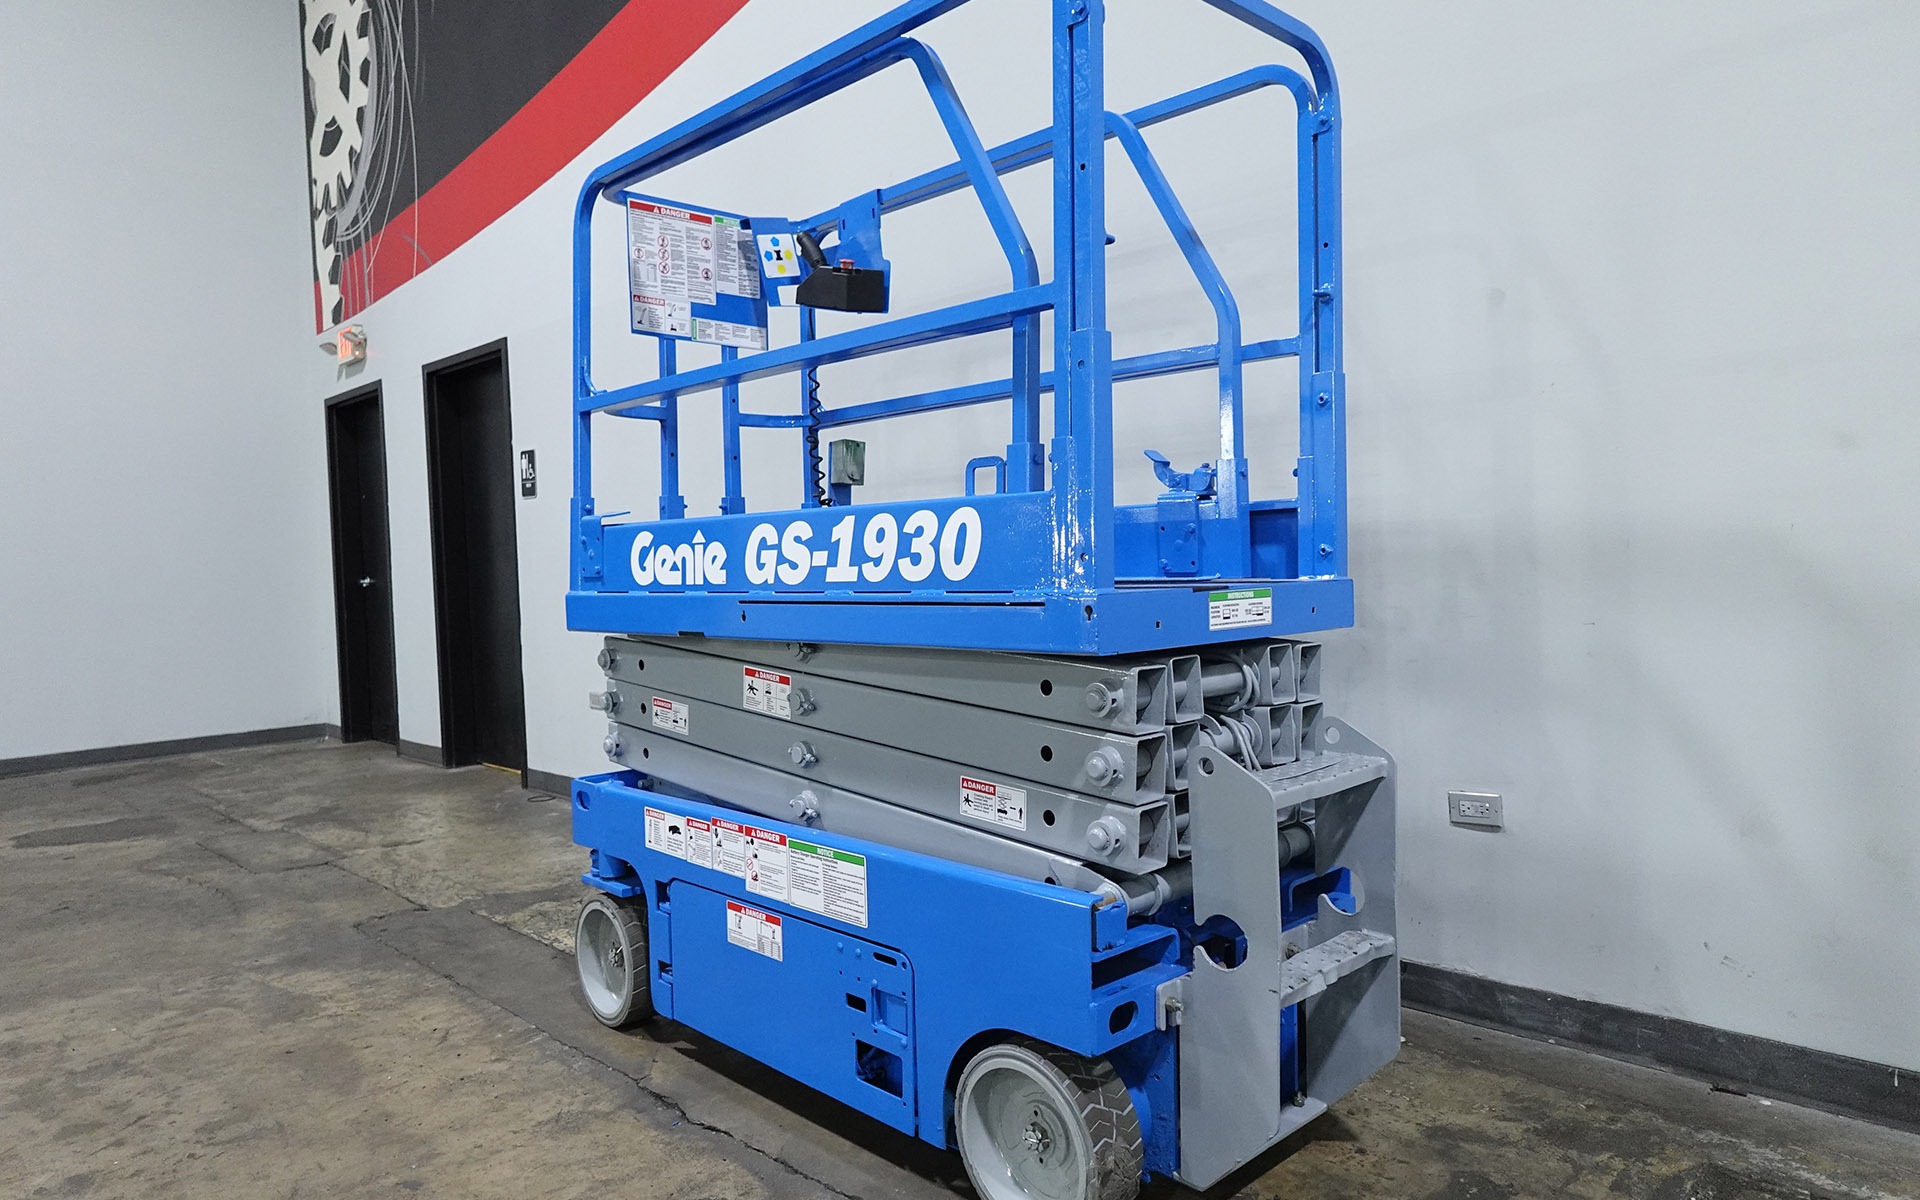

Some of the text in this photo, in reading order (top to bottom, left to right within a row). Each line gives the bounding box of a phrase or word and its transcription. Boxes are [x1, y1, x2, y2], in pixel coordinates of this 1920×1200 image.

[661, 207, 690, 220] DANGER
[630, 506, 982, 586] Genie GS-1930
[760, 672, 780, 682] DANGER
[968, 781, 995, 793] DANGER
[691, 821, 708, 830] DANGER
[720, 820, 739, 831] DANGER
[757, 830, 780, 843] DANGER
[816, 847, 834, 858] NOTICE
[746, 908, 766, 921] DANGER
